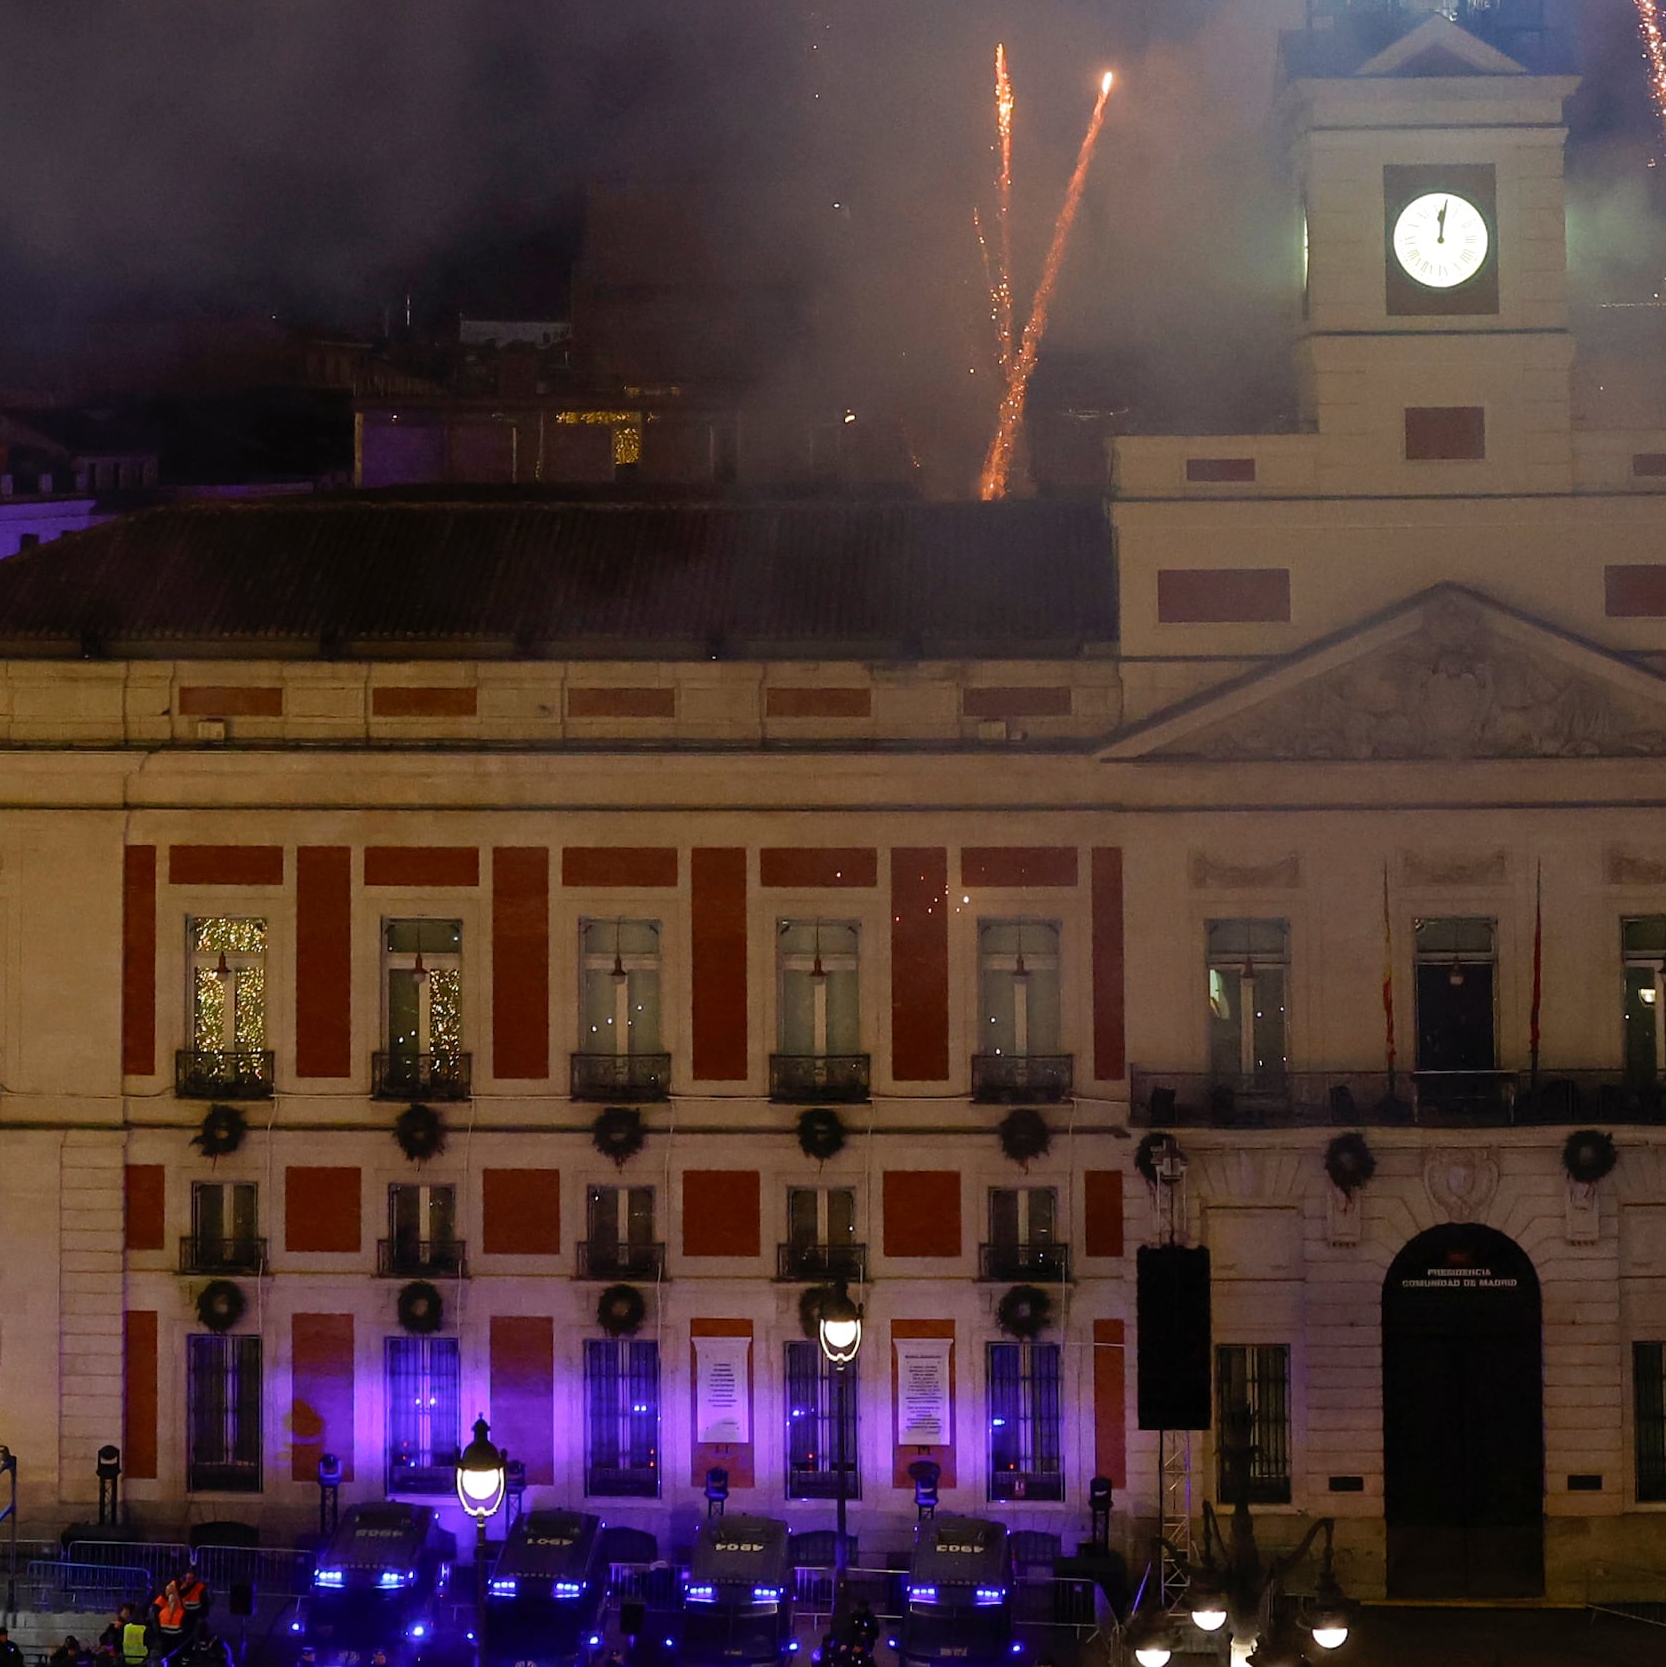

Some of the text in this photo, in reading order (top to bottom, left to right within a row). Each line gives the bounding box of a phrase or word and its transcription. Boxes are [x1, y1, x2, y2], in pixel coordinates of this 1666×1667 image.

[1402, 1278, 1517, 1287] COMUNIDAD DE MADRID
